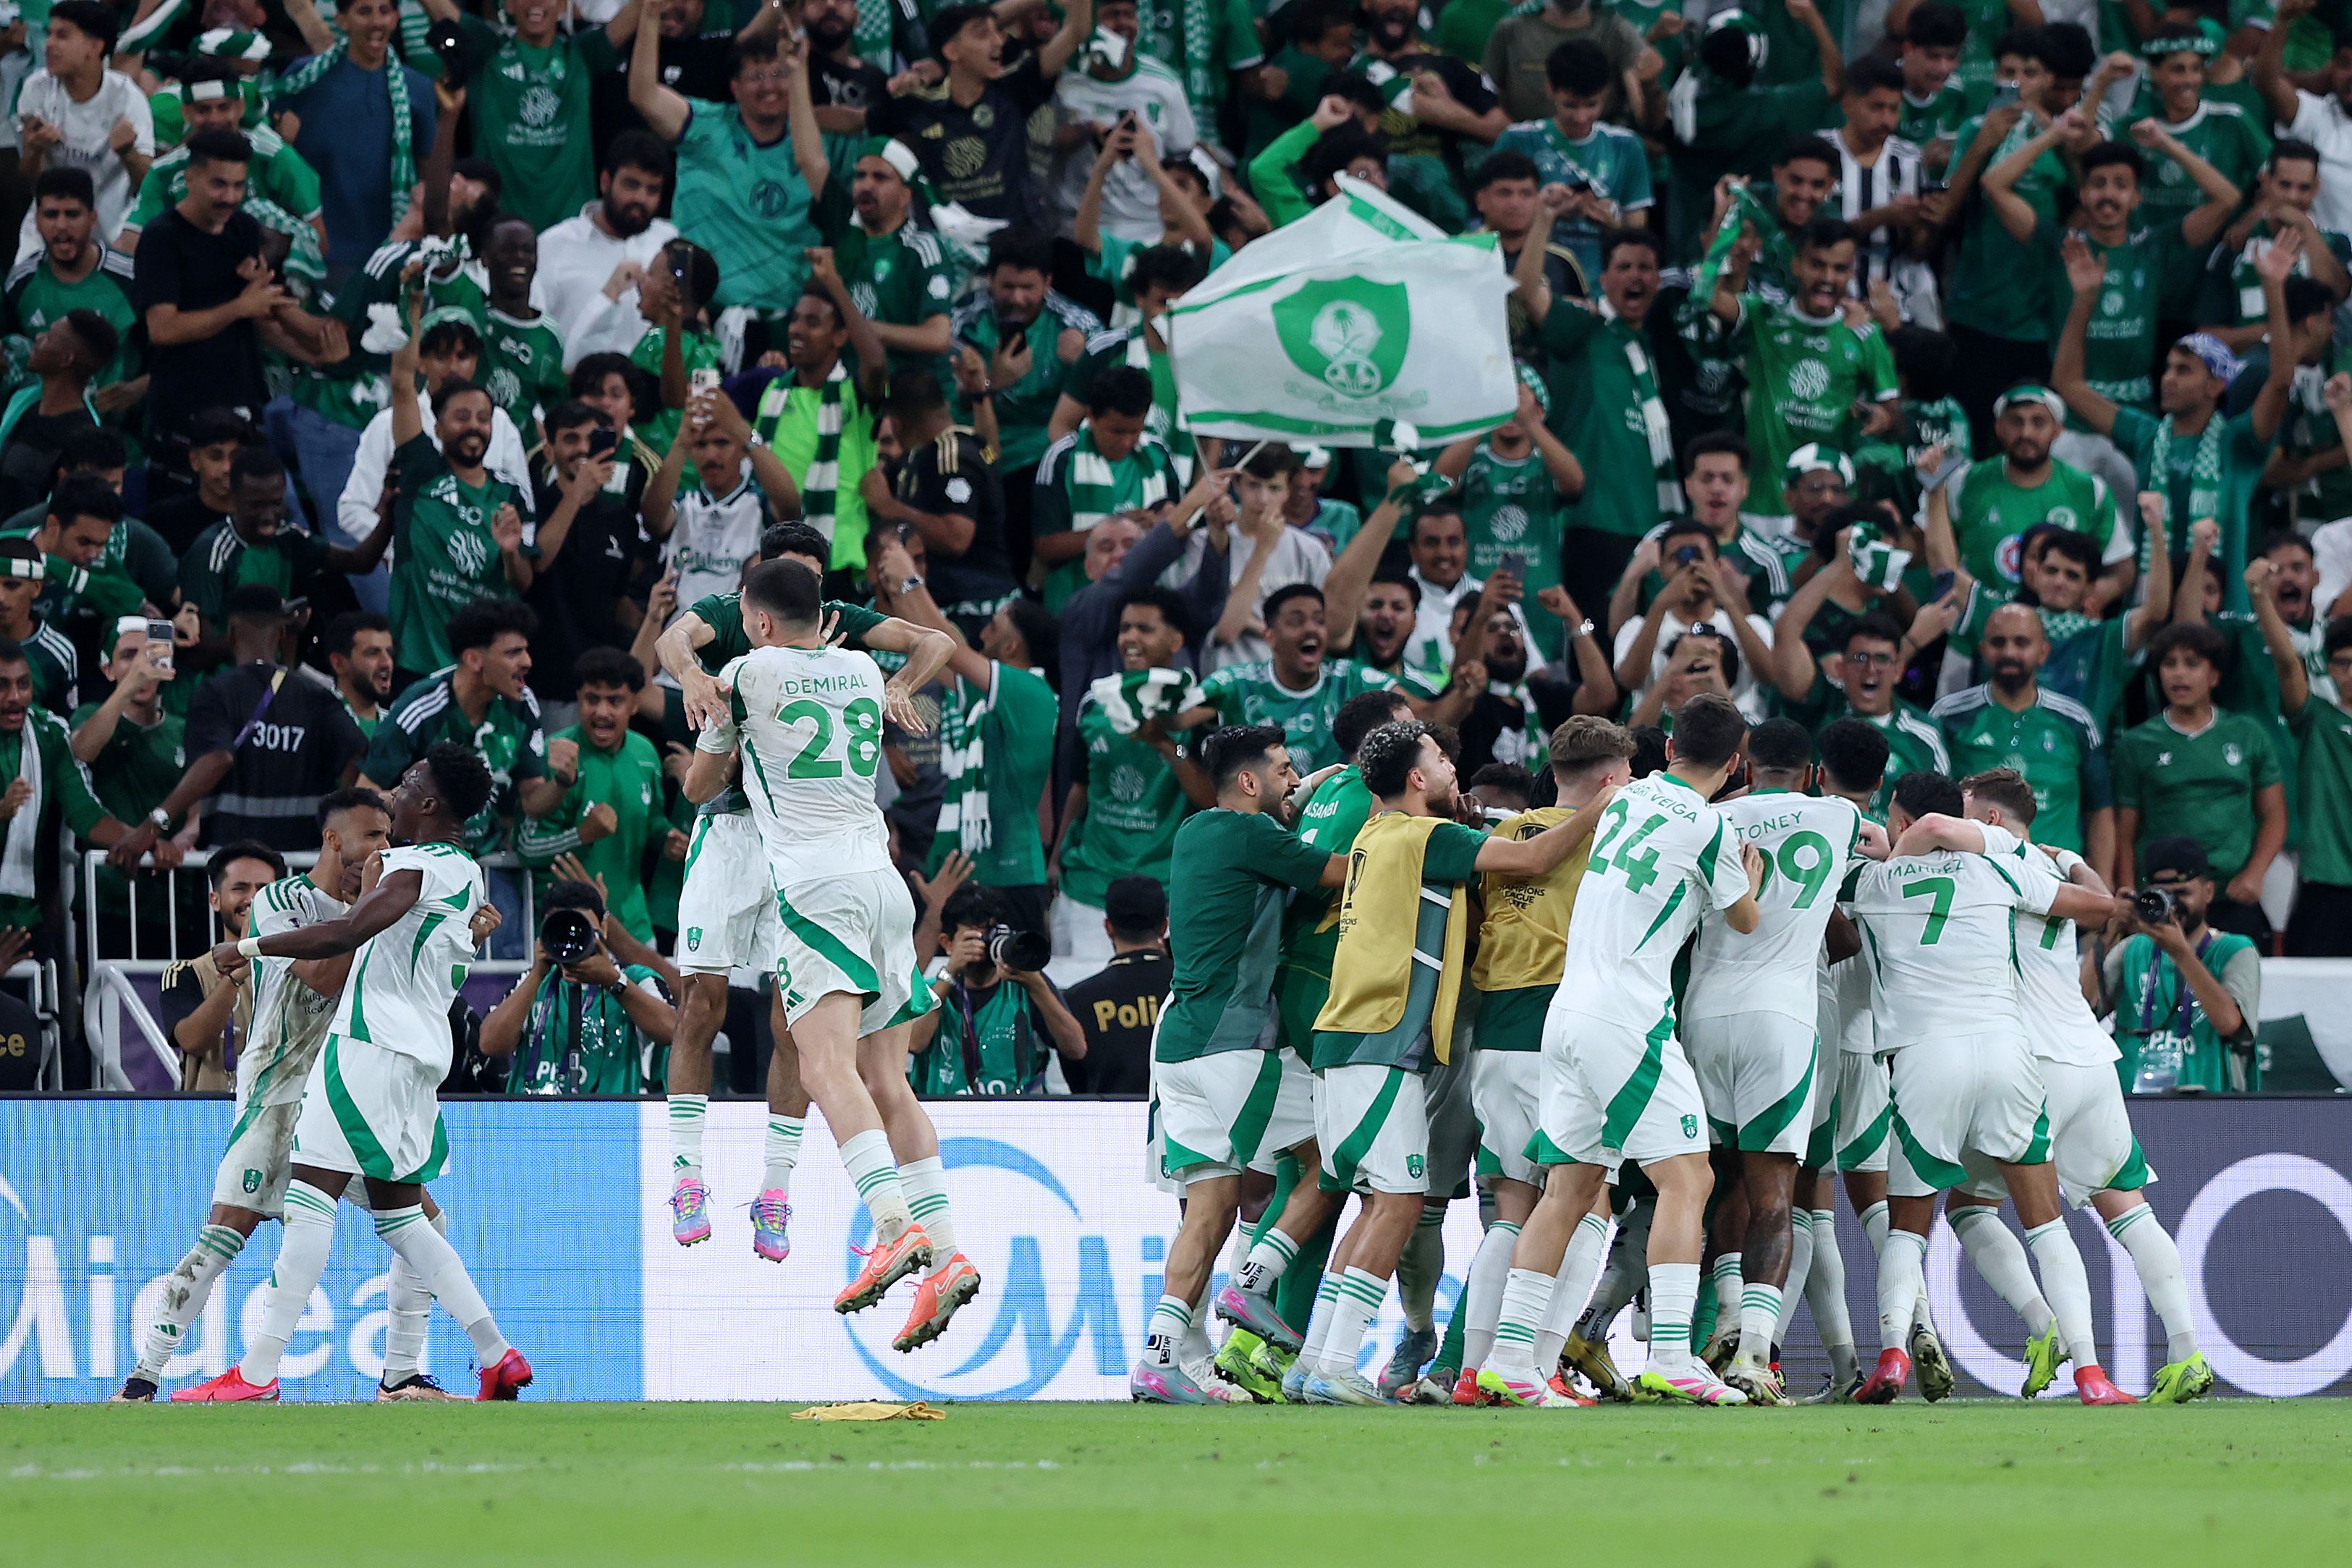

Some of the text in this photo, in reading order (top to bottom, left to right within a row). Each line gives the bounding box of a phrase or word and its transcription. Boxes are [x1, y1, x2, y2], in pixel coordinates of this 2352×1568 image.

[784, 673, 868, 695] DEMIRAL
[252, 719, 305, 753] 3017
[775, 697, 881, 779] 28
[1650, 794, 1698, 823] VEIGA
[1735, 810, 1803, 839] TONEY
[1587, 798, 1669, 894] 24
[1504, 890, 1536, 904] EAGUE
[1902, 876, 1955, 946] 7
